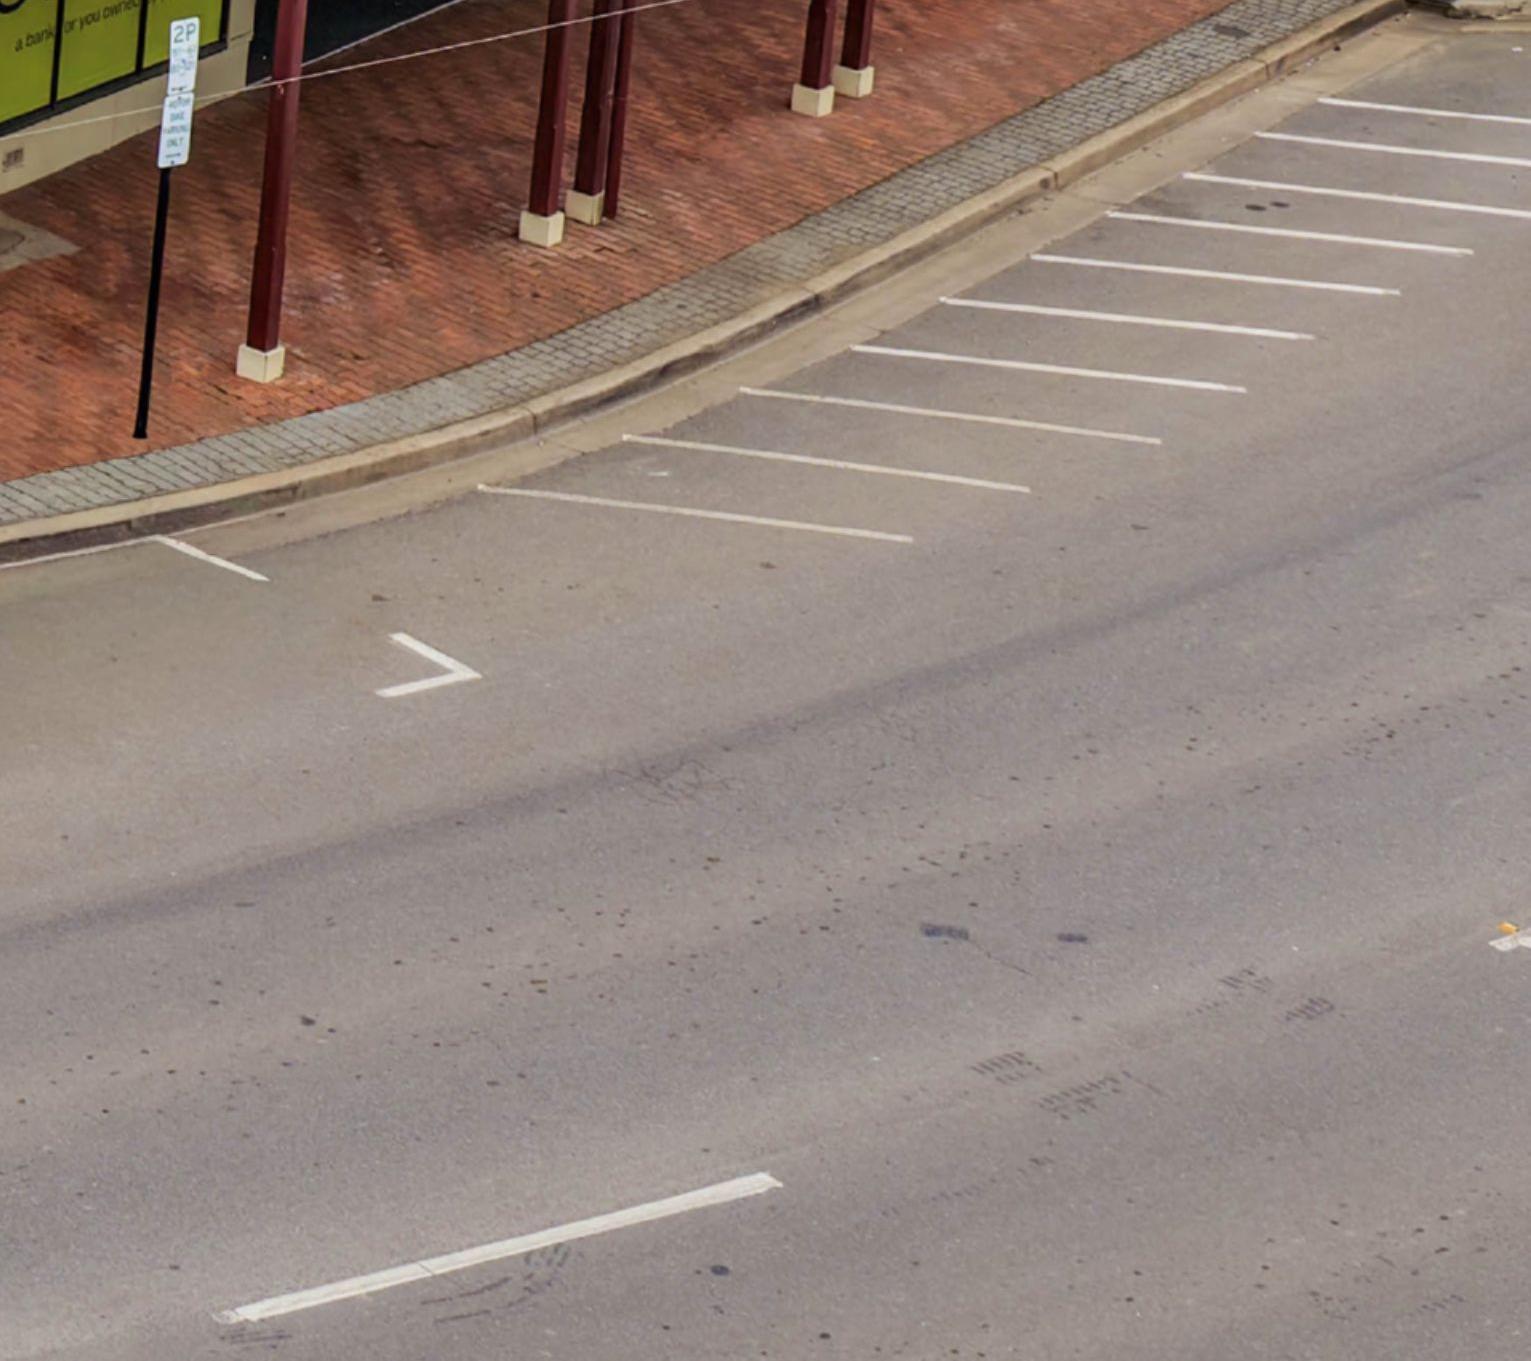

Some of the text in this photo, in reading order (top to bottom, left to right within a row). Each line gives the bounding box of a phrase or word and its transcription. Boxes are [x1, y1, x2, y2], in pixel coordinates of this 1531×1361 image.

[15, 39, 23, 52] a
[26, 23, 56, 47] bank
[79, 10, 101, 31] you
[173, 22, 196, 43] 2P
